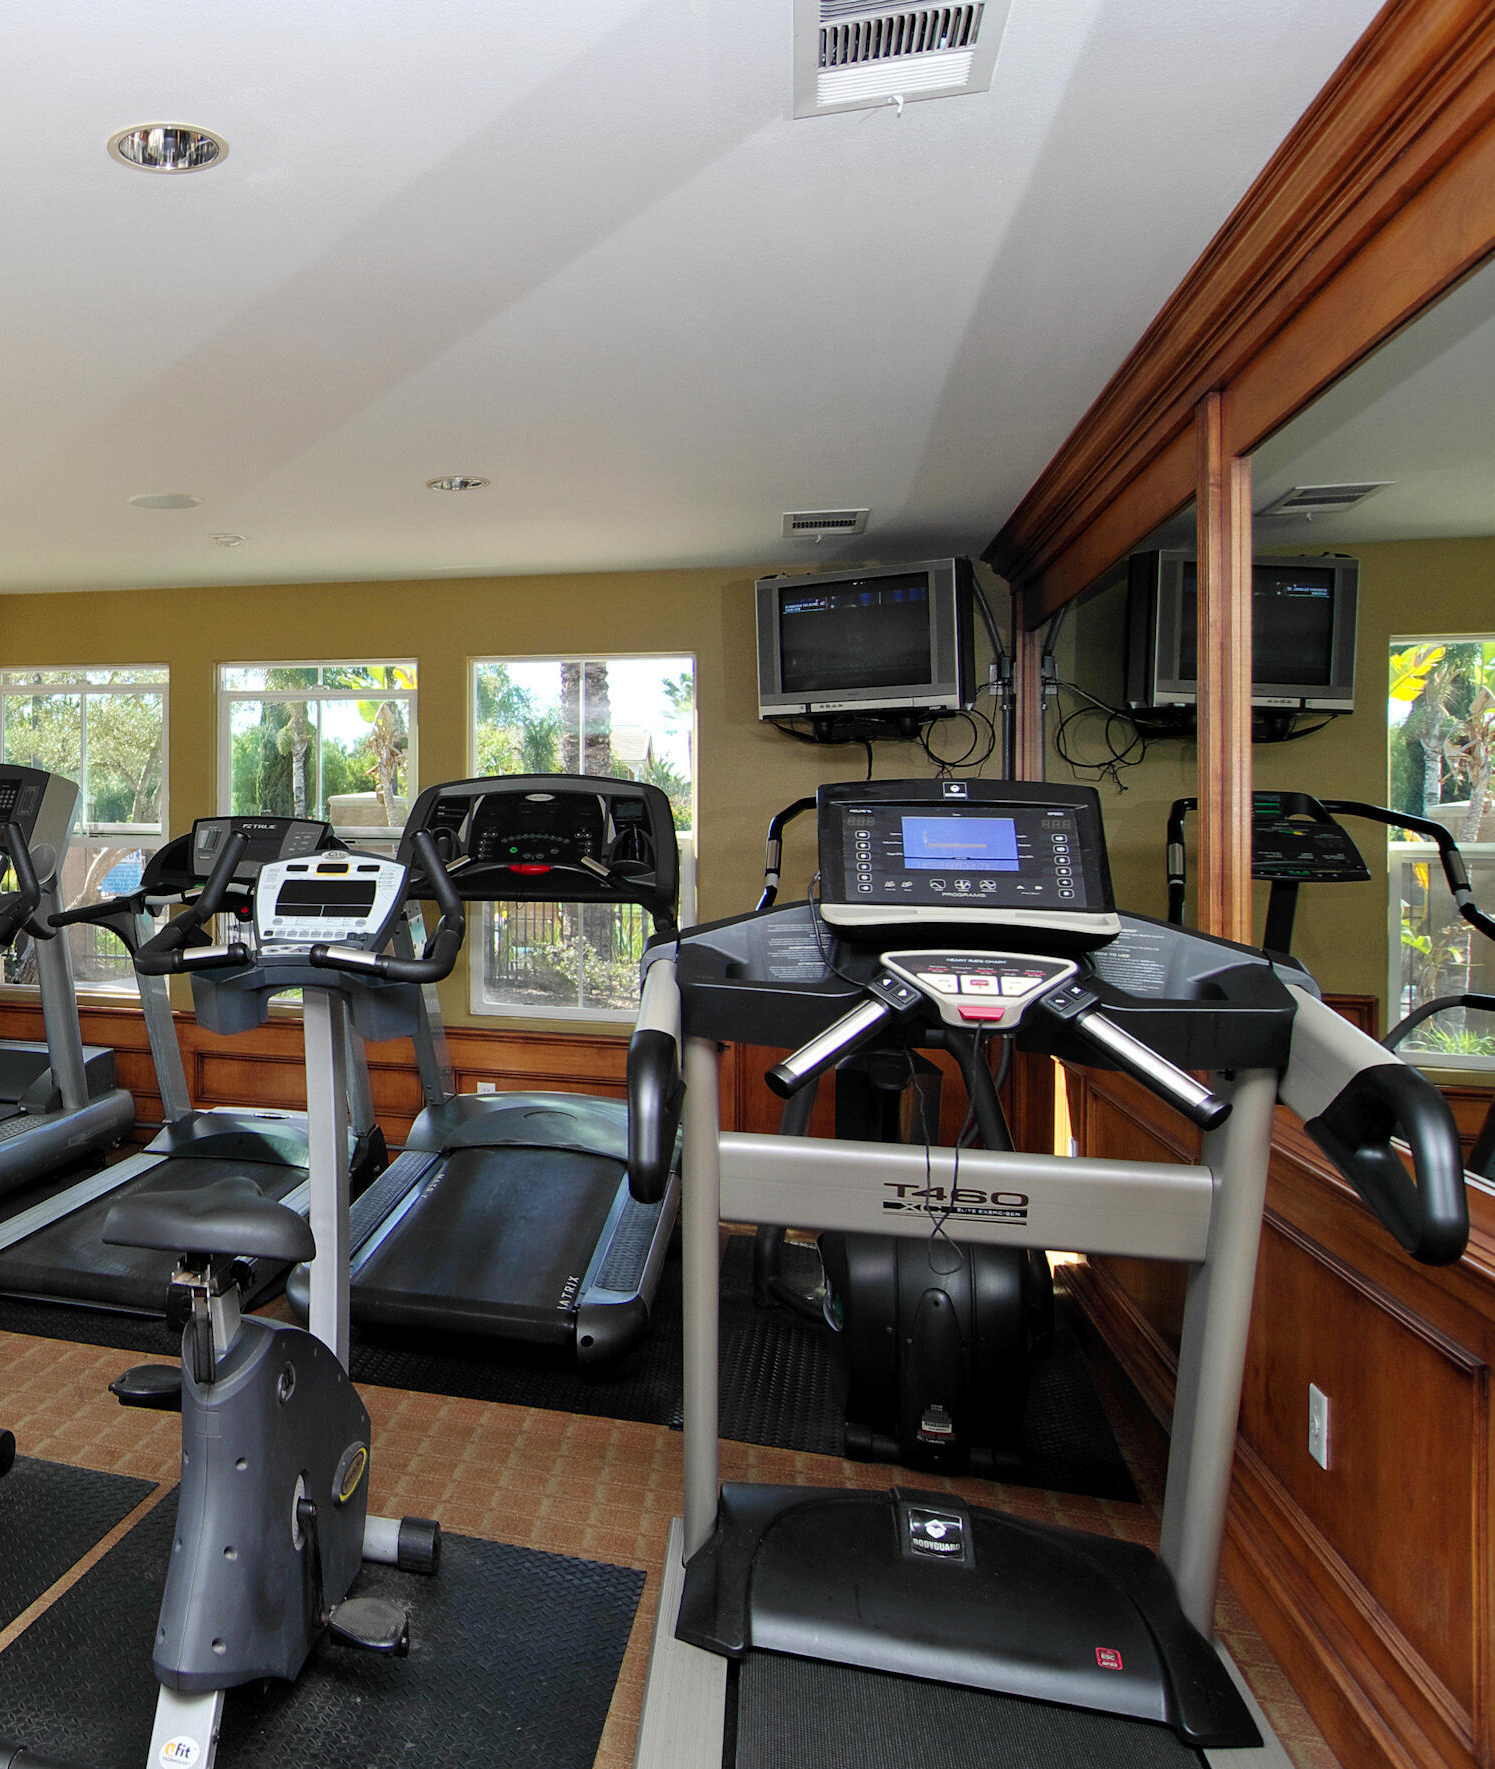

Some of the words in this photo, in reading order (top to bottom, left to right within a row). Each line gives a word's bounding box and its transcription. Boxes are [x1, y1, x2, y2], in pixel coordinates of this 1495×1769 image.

[884, 1182, 1030, 1207] T460
[978, 1209, 1021, 1217] EXERCISER
[912, 1537, 961, 1552] BODYGUARD
